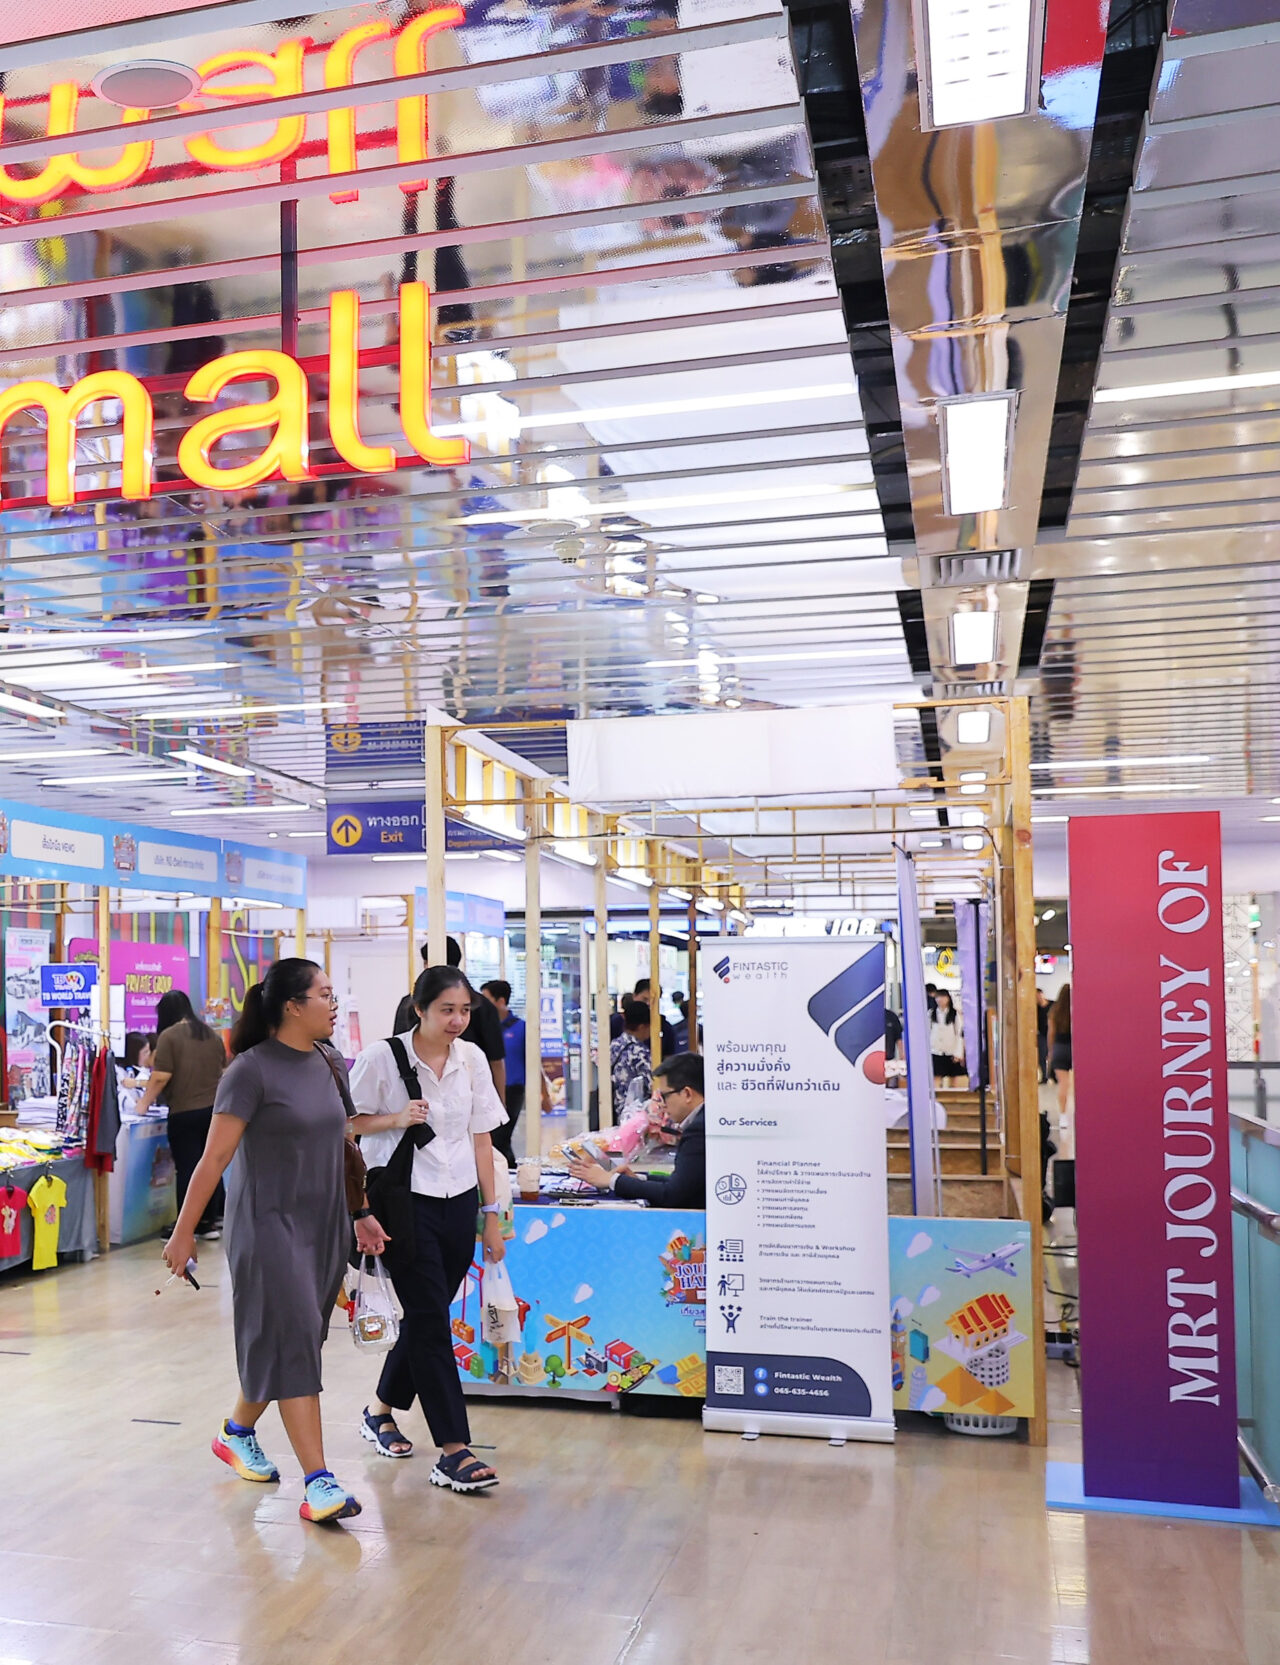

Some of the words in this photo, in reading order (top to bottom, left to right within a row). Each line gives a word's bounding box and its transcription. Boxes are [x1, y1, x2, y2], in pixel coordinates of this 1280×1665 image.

[367, 815, 419, 827] ทางออก
[381, 831, 403, 843] Exit
[1157, 849, 1211, 936] OF
[716, 1040, 786, 1055] พร้อมพาคุณ
[716, 1057, 791, 1075] สู่ความมั่งคั่ง
[717, 1081, 737, 1091] และ
[741, 1076, 840, 1091] ชีวิตที่ฟินกว่าเดิม
[1159, 954, 1218, 1259] JOURNEY
[719, 1117, 737, 1126] Our
[739, 1117, 777, 1127] Services
[1167, 1267, 1220, 1407] MRT
[774, 1371, 810, 1380] Fintastic
[812, 1374, 843, 1382] Wealth
